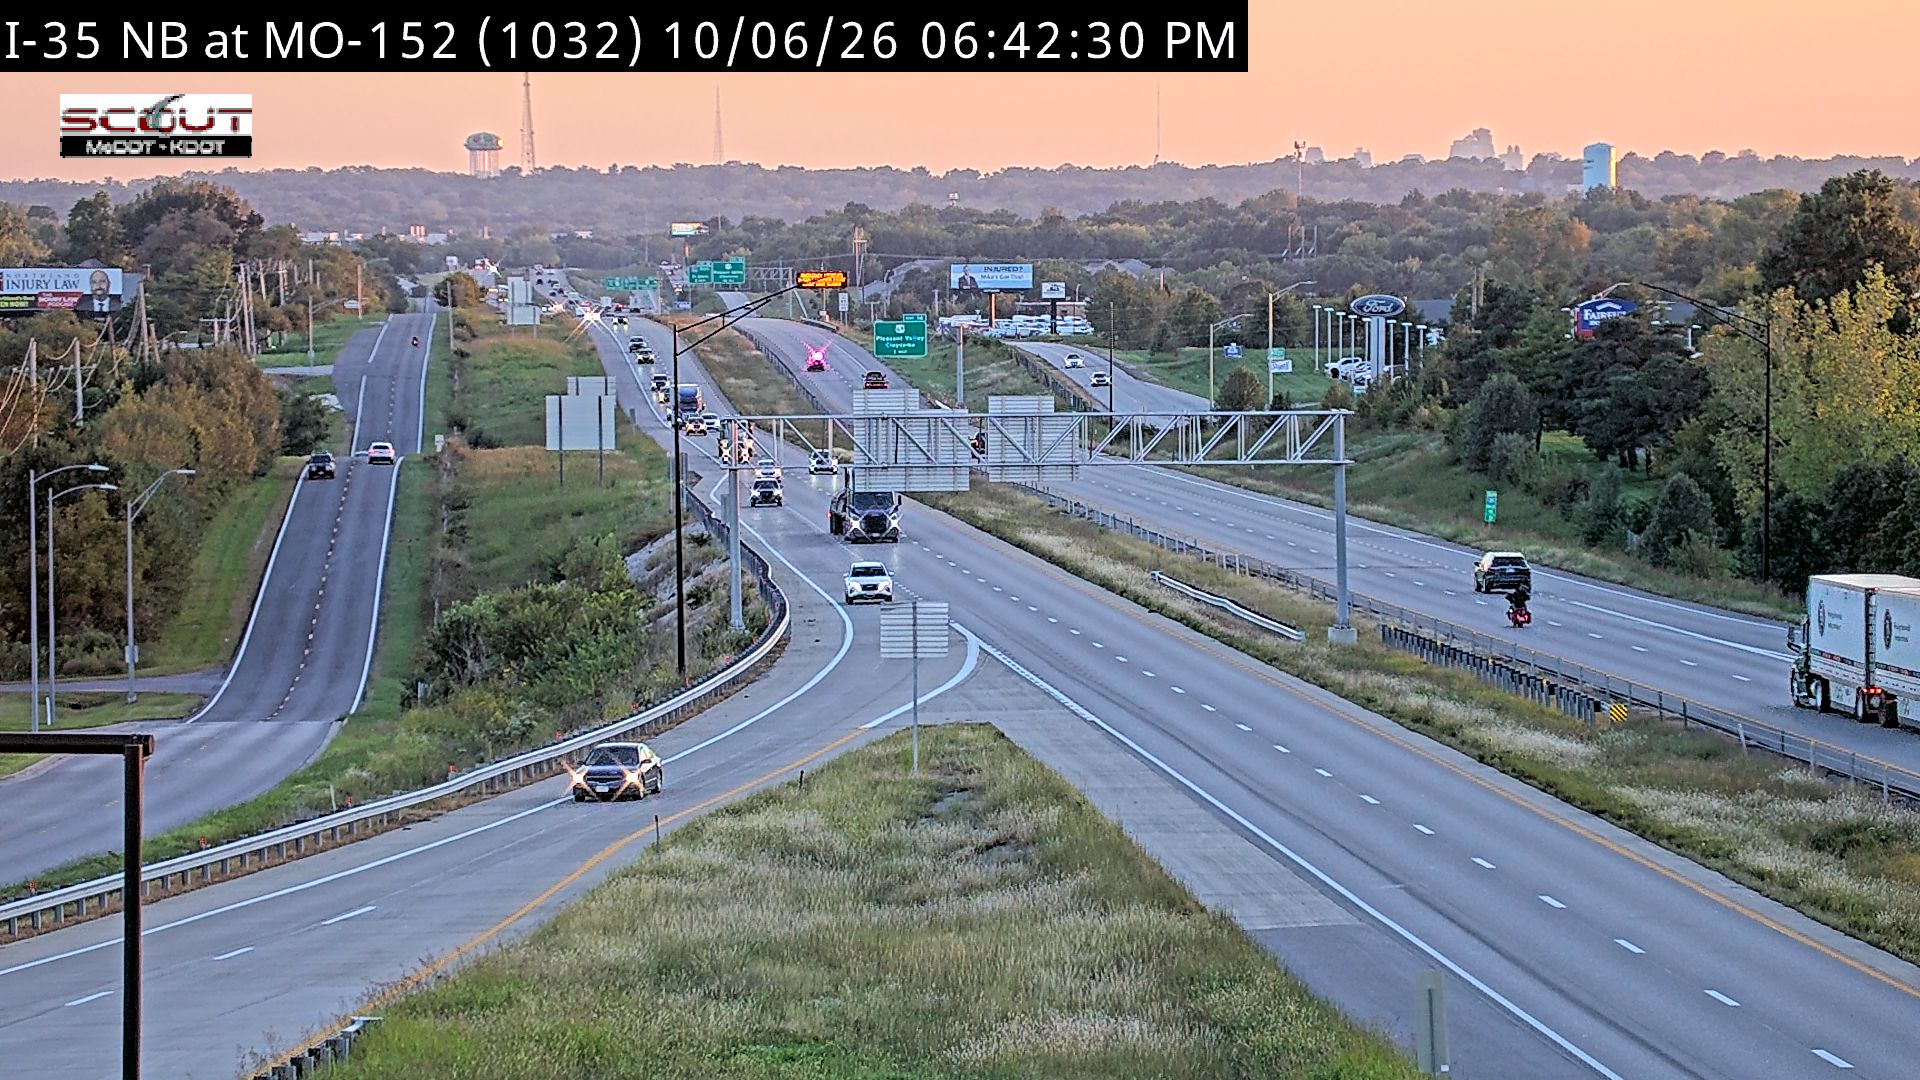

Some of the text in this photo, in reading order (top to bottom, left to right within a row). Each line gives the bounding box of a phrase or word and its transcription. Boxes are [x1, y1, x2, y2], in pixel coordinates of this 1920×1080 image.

[6, 279, 80, 291] INJURY LAW
[1362, 299, 1395, 313] Ford
